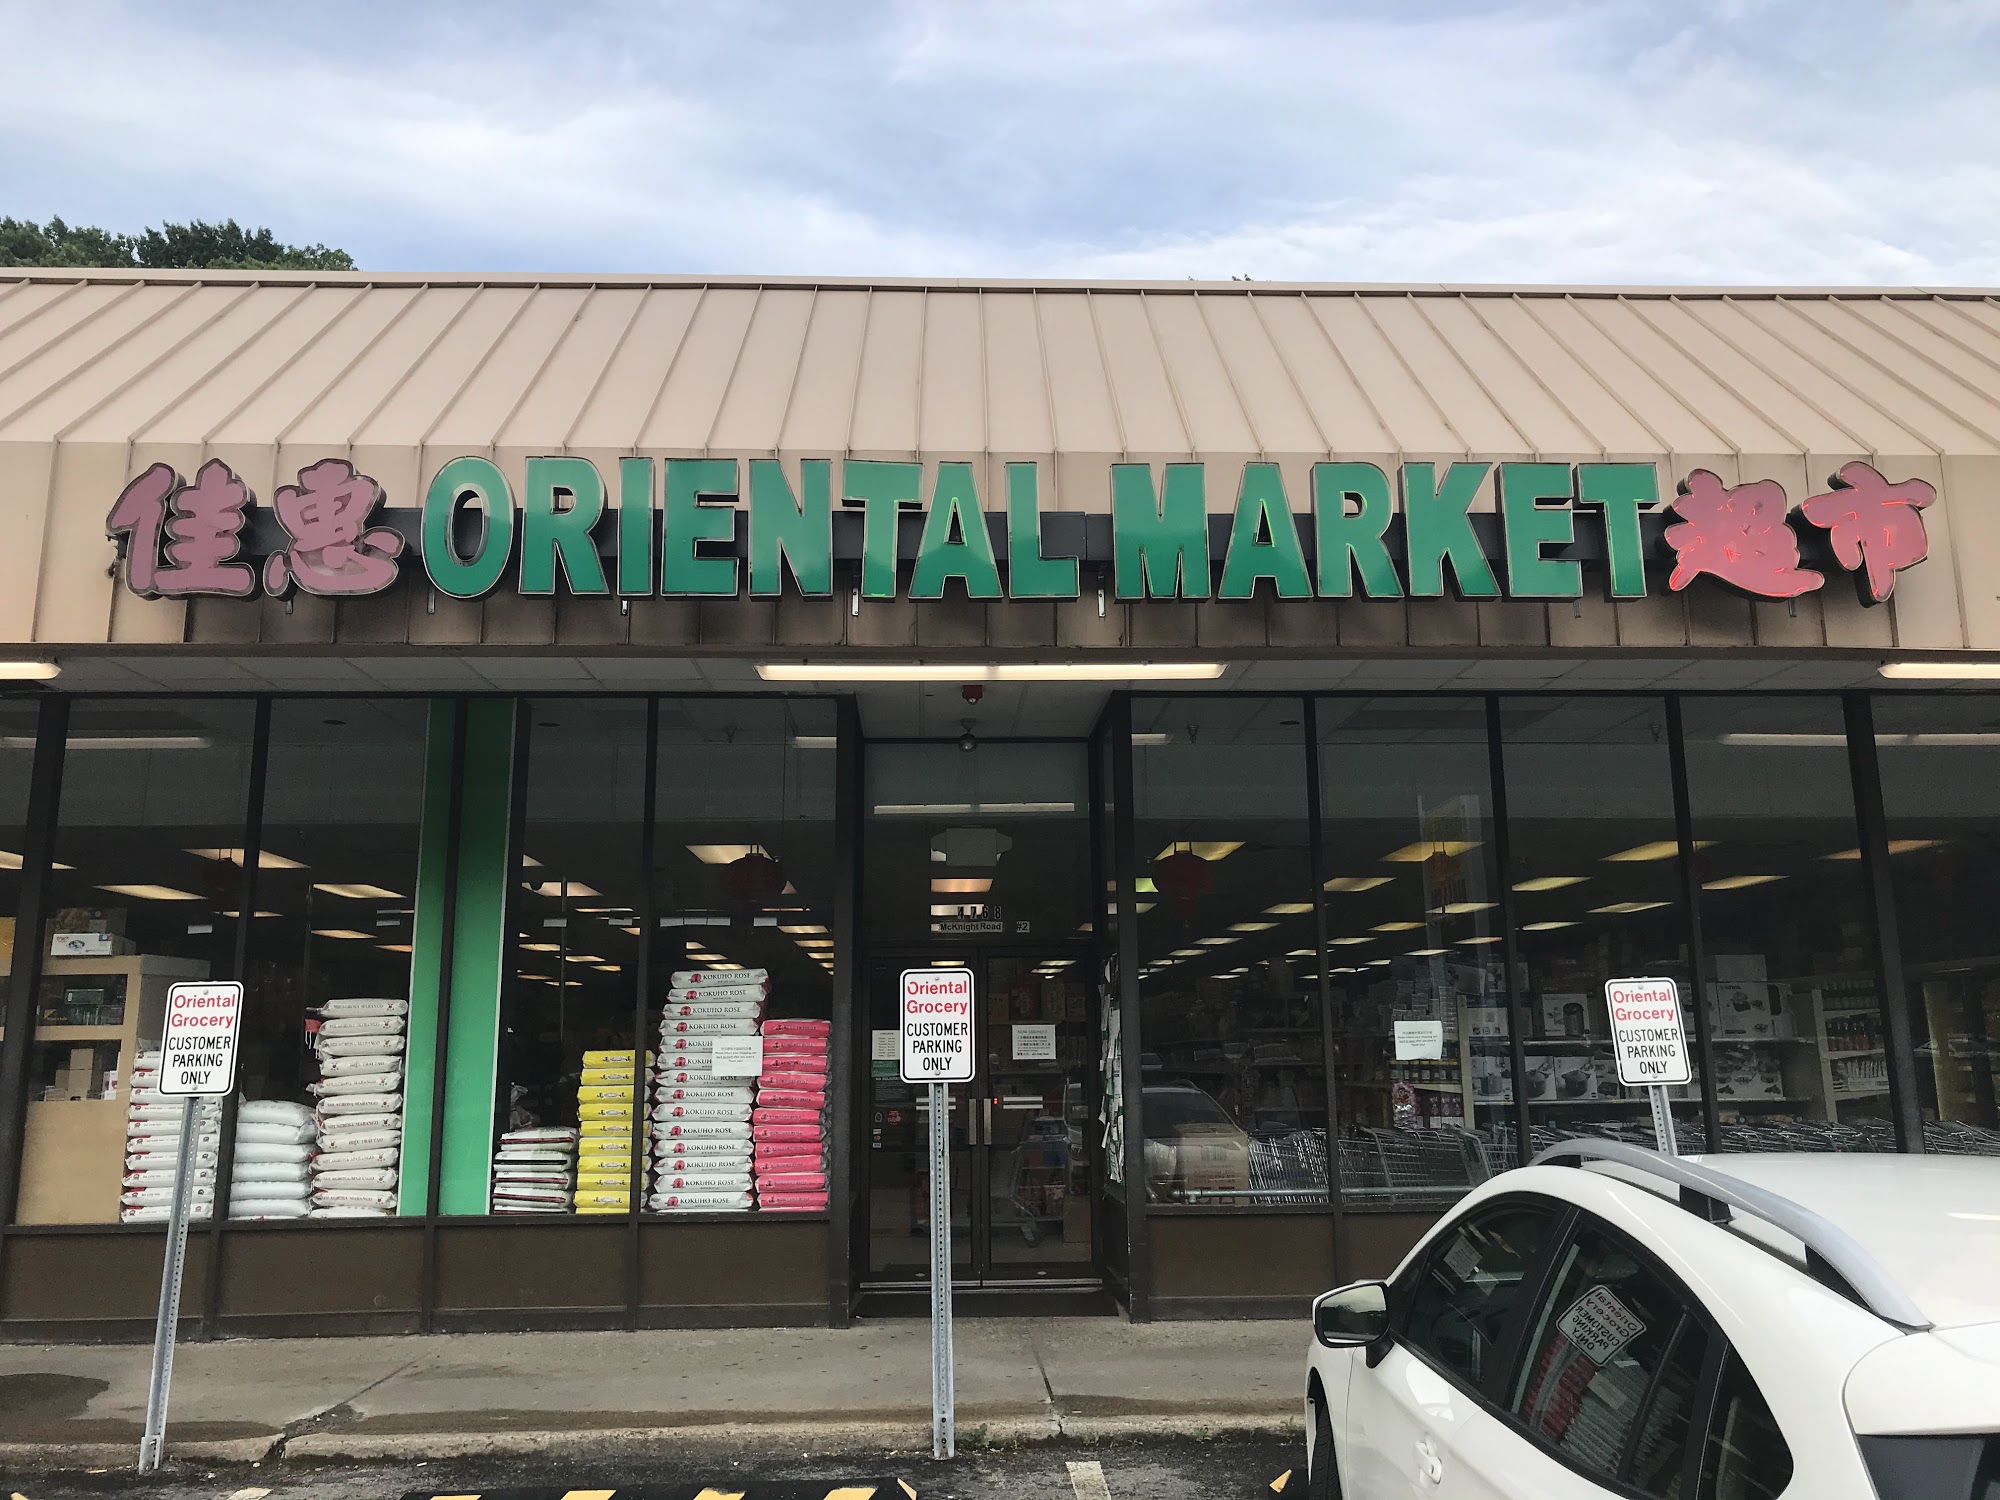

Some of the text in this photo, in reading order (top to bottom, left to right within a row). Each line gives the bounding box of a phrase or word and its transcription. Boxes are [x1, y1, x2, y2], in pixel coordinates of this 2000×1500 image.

[106, 458, 405, 600] 佳惠
[421, 455, 1660, 602] ORIENTAL MARKET
[1662, 461, 1937, 606] 超市
[958, 907, 1001, 919] 4768
[941, 922, 1028, 931] McKnight Road #2
[907, 980, 967, 995] Oriental
[174, 994, 236, 1009] Oriental
[1613, 989, 1671, 1003] Oriental
[907, 1000, 968, 1015] Grocery
[1615, 1008, 1674, 1021] Grocery
[172, 1013, 234, 1028] Grocery
[907, 1023, 968, 1036] CUSTOMER
[1619, 1028, 1679, 1042] CUSTOMER
[168, 1036, 232, 1050] CUSTOMER
[913, 1040, 962, 1053] PARKING
[1627, 1044, 1676, 1058] PARKING
[172, 1053, 223, 1067] PARKING
[923, 1057, 952, 1070] ONLY
[1640, 1061, 1667, 1074] ONLY
[181, 1071, 211, 1084] ONLY
